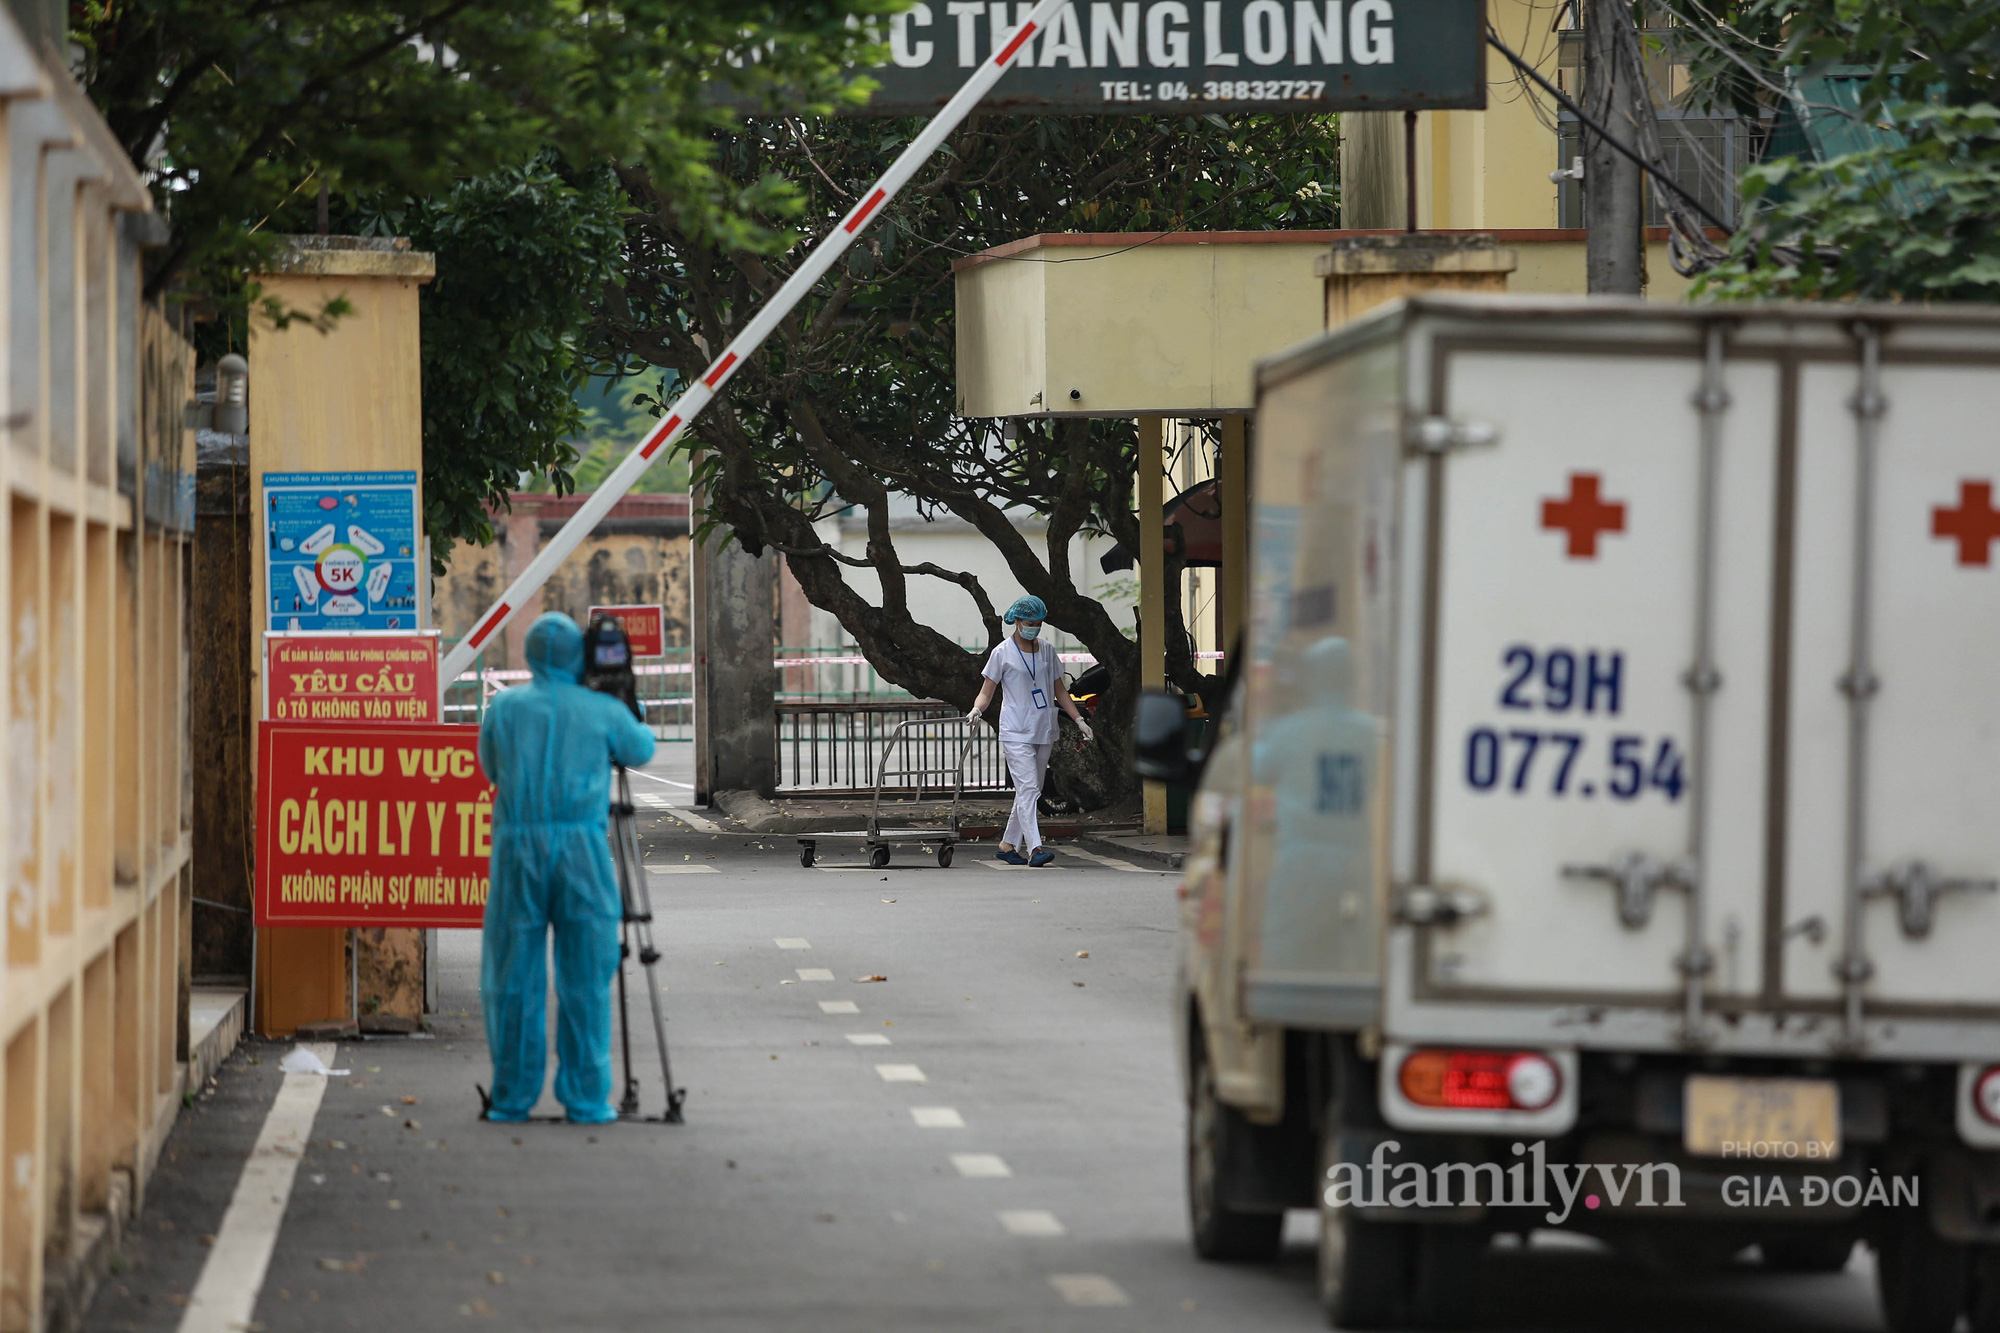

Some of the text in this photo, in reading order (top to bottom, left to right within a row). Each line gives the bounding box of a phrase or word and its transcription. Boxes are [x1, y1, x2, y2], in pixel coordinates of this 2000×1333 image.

[1203, 0, 1394, 66] LONG
[1100, 80, 1326, 101] TEL: 04. 38832727
[331, 568, 354, 582] 5K
[290, 664, 415, 692] YÊU CẦU
[1499, 645, 1625, 715] 29H
[277, 697, 428, 721] Ô TÔ KHÔNG VÀO VIỆN
[304, 746, 475, 783] KHU VỰC
[1466, 727, 1685, 801] 077.54
[279, 783, 496, 857] CÁCH LY Y TẾ
[281, 866, 491, 910] KHÔNG PHẬN SỰ MIỄN VÀO
